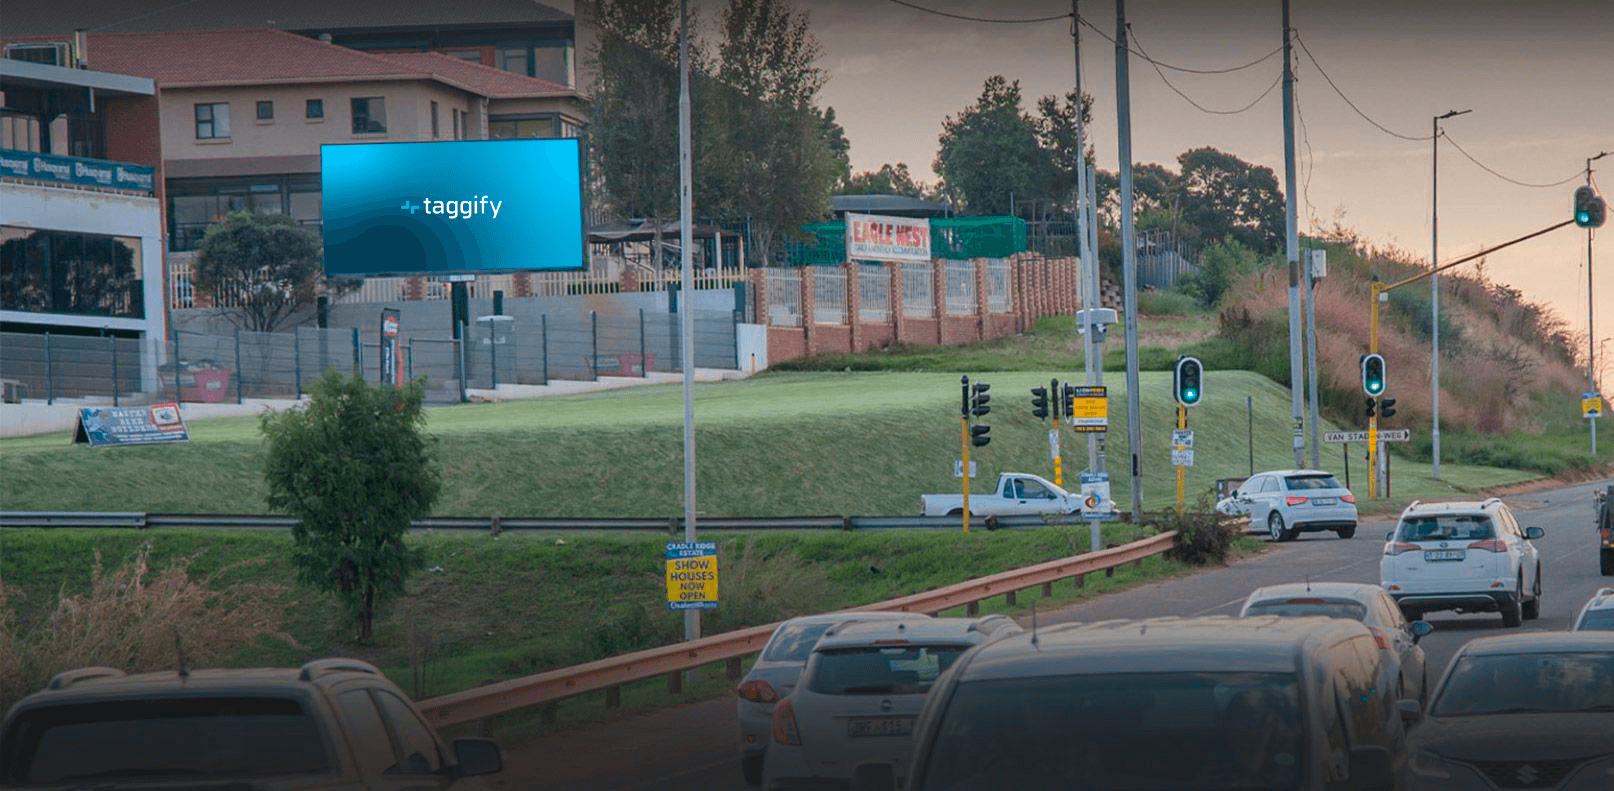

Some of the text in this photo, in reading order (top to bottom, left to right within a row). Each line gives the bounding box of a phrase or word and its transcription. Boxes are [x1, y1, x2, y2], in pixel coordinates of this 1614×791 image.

[423, 195, 502, 219] taggify
[853, 221, 928, 247] EAGLE NEST
[1327, 432, 1344, 441] VAN
[674, 560, 709, 570] SHOW
[671, 571, 714, 581] HOUSES
[680, 582, 705, 590] NOW
[679, 591, 705, 600] OPEN
